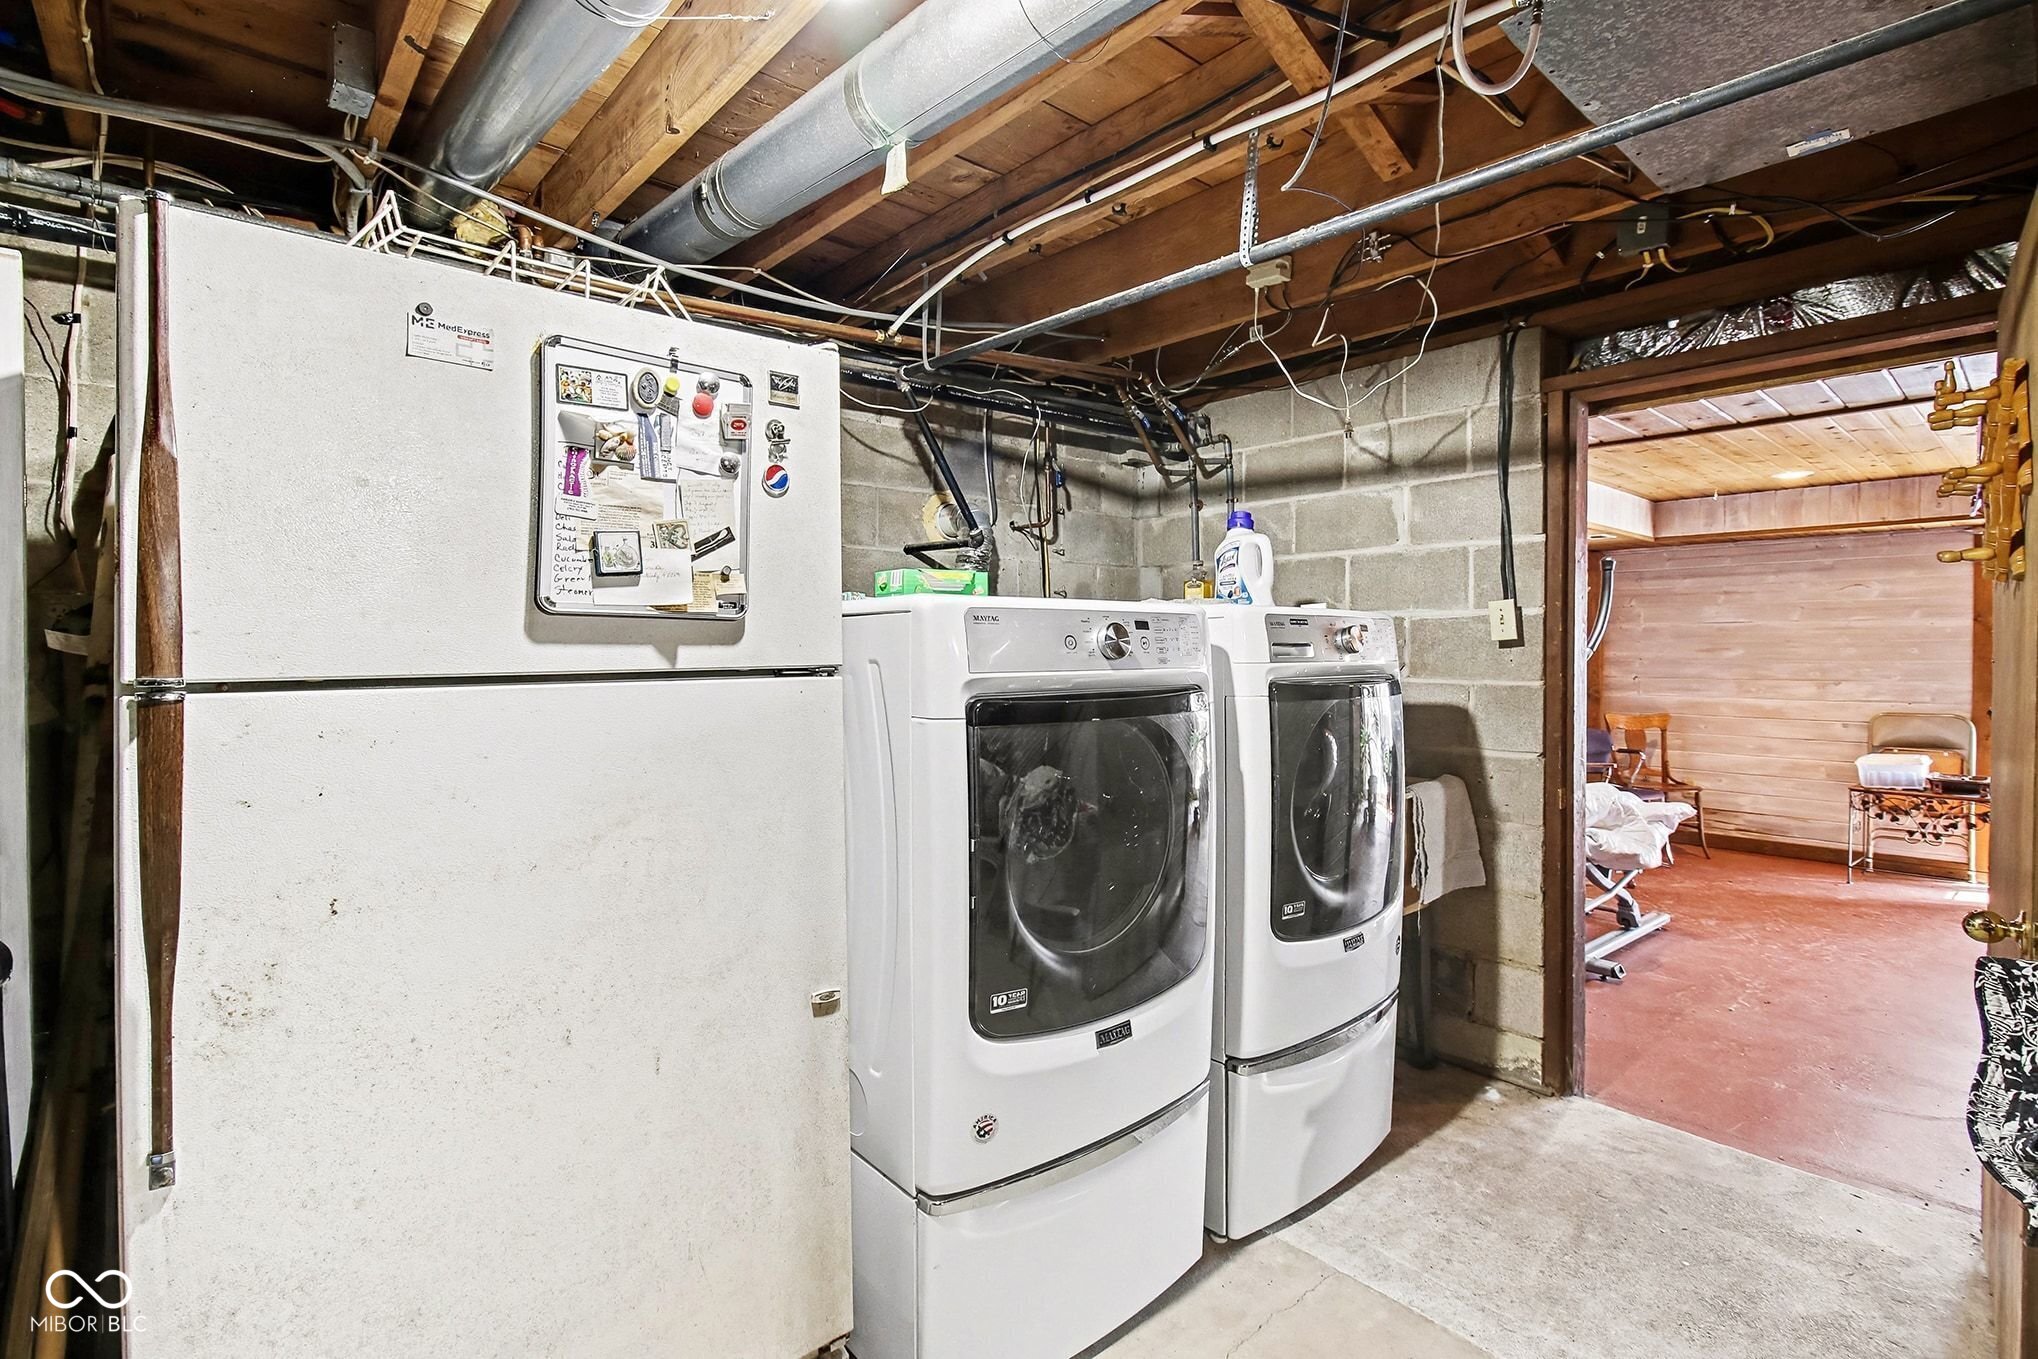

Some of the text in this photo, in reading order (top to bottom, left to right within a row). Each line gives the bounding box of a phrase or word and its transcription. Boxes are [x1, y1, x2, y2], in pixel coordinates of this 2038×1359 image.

[437, 321, 490, 339] MedExpress
[1284, 905, 1293, 915] 10
[992, 994, 1008, 1008] 10
